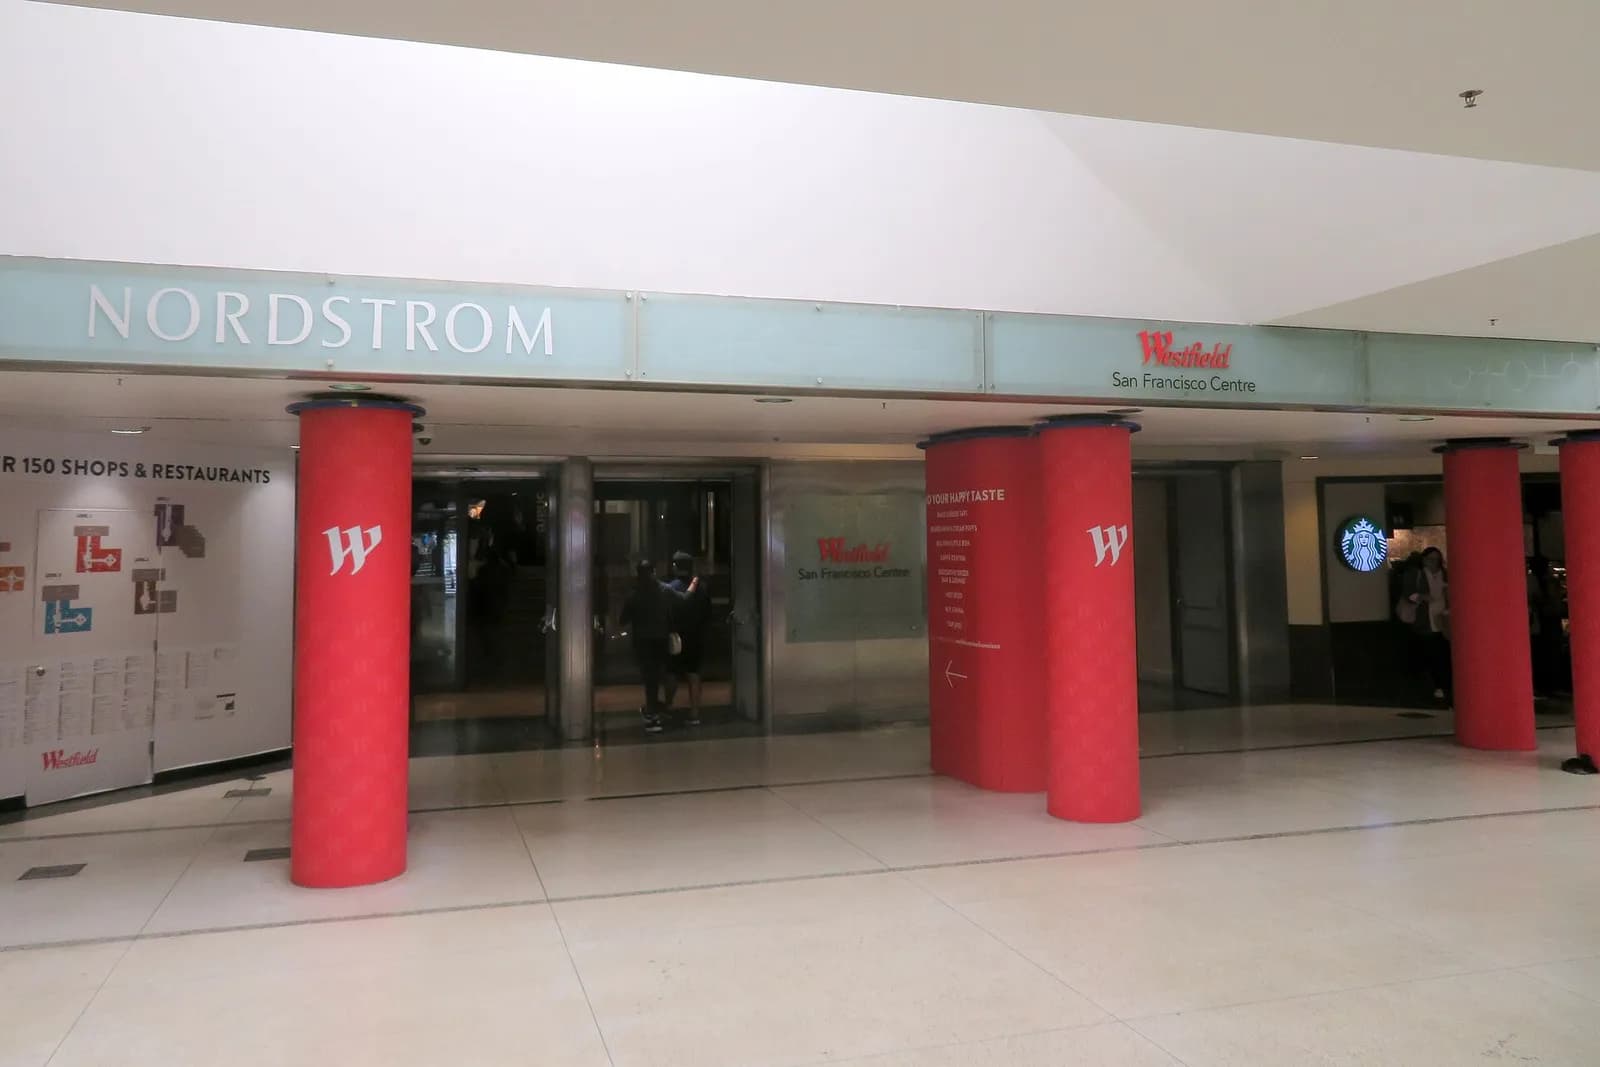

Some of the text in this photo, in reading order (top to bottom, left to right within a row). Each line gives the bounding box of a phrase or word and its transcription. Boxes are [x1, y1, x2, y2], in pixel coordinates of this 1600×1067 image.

[88, 284, 554, 356] NORDSTROM
[1137, 329, 1233, 369] Westfield
[1112, 372, 1256, 393] San Francisco Centre
[0, 456, 270, 484] R 150 SHOPS & RESTAURANTS
[932, 493, 949, 505] YOUR
[950, 490, 970, 504] HAPPY
[971, 489, 1005, 502] TASTE
[798, 567, 910, 580] San Francisco Centre
[42, 748, 99, 770] Westfield
